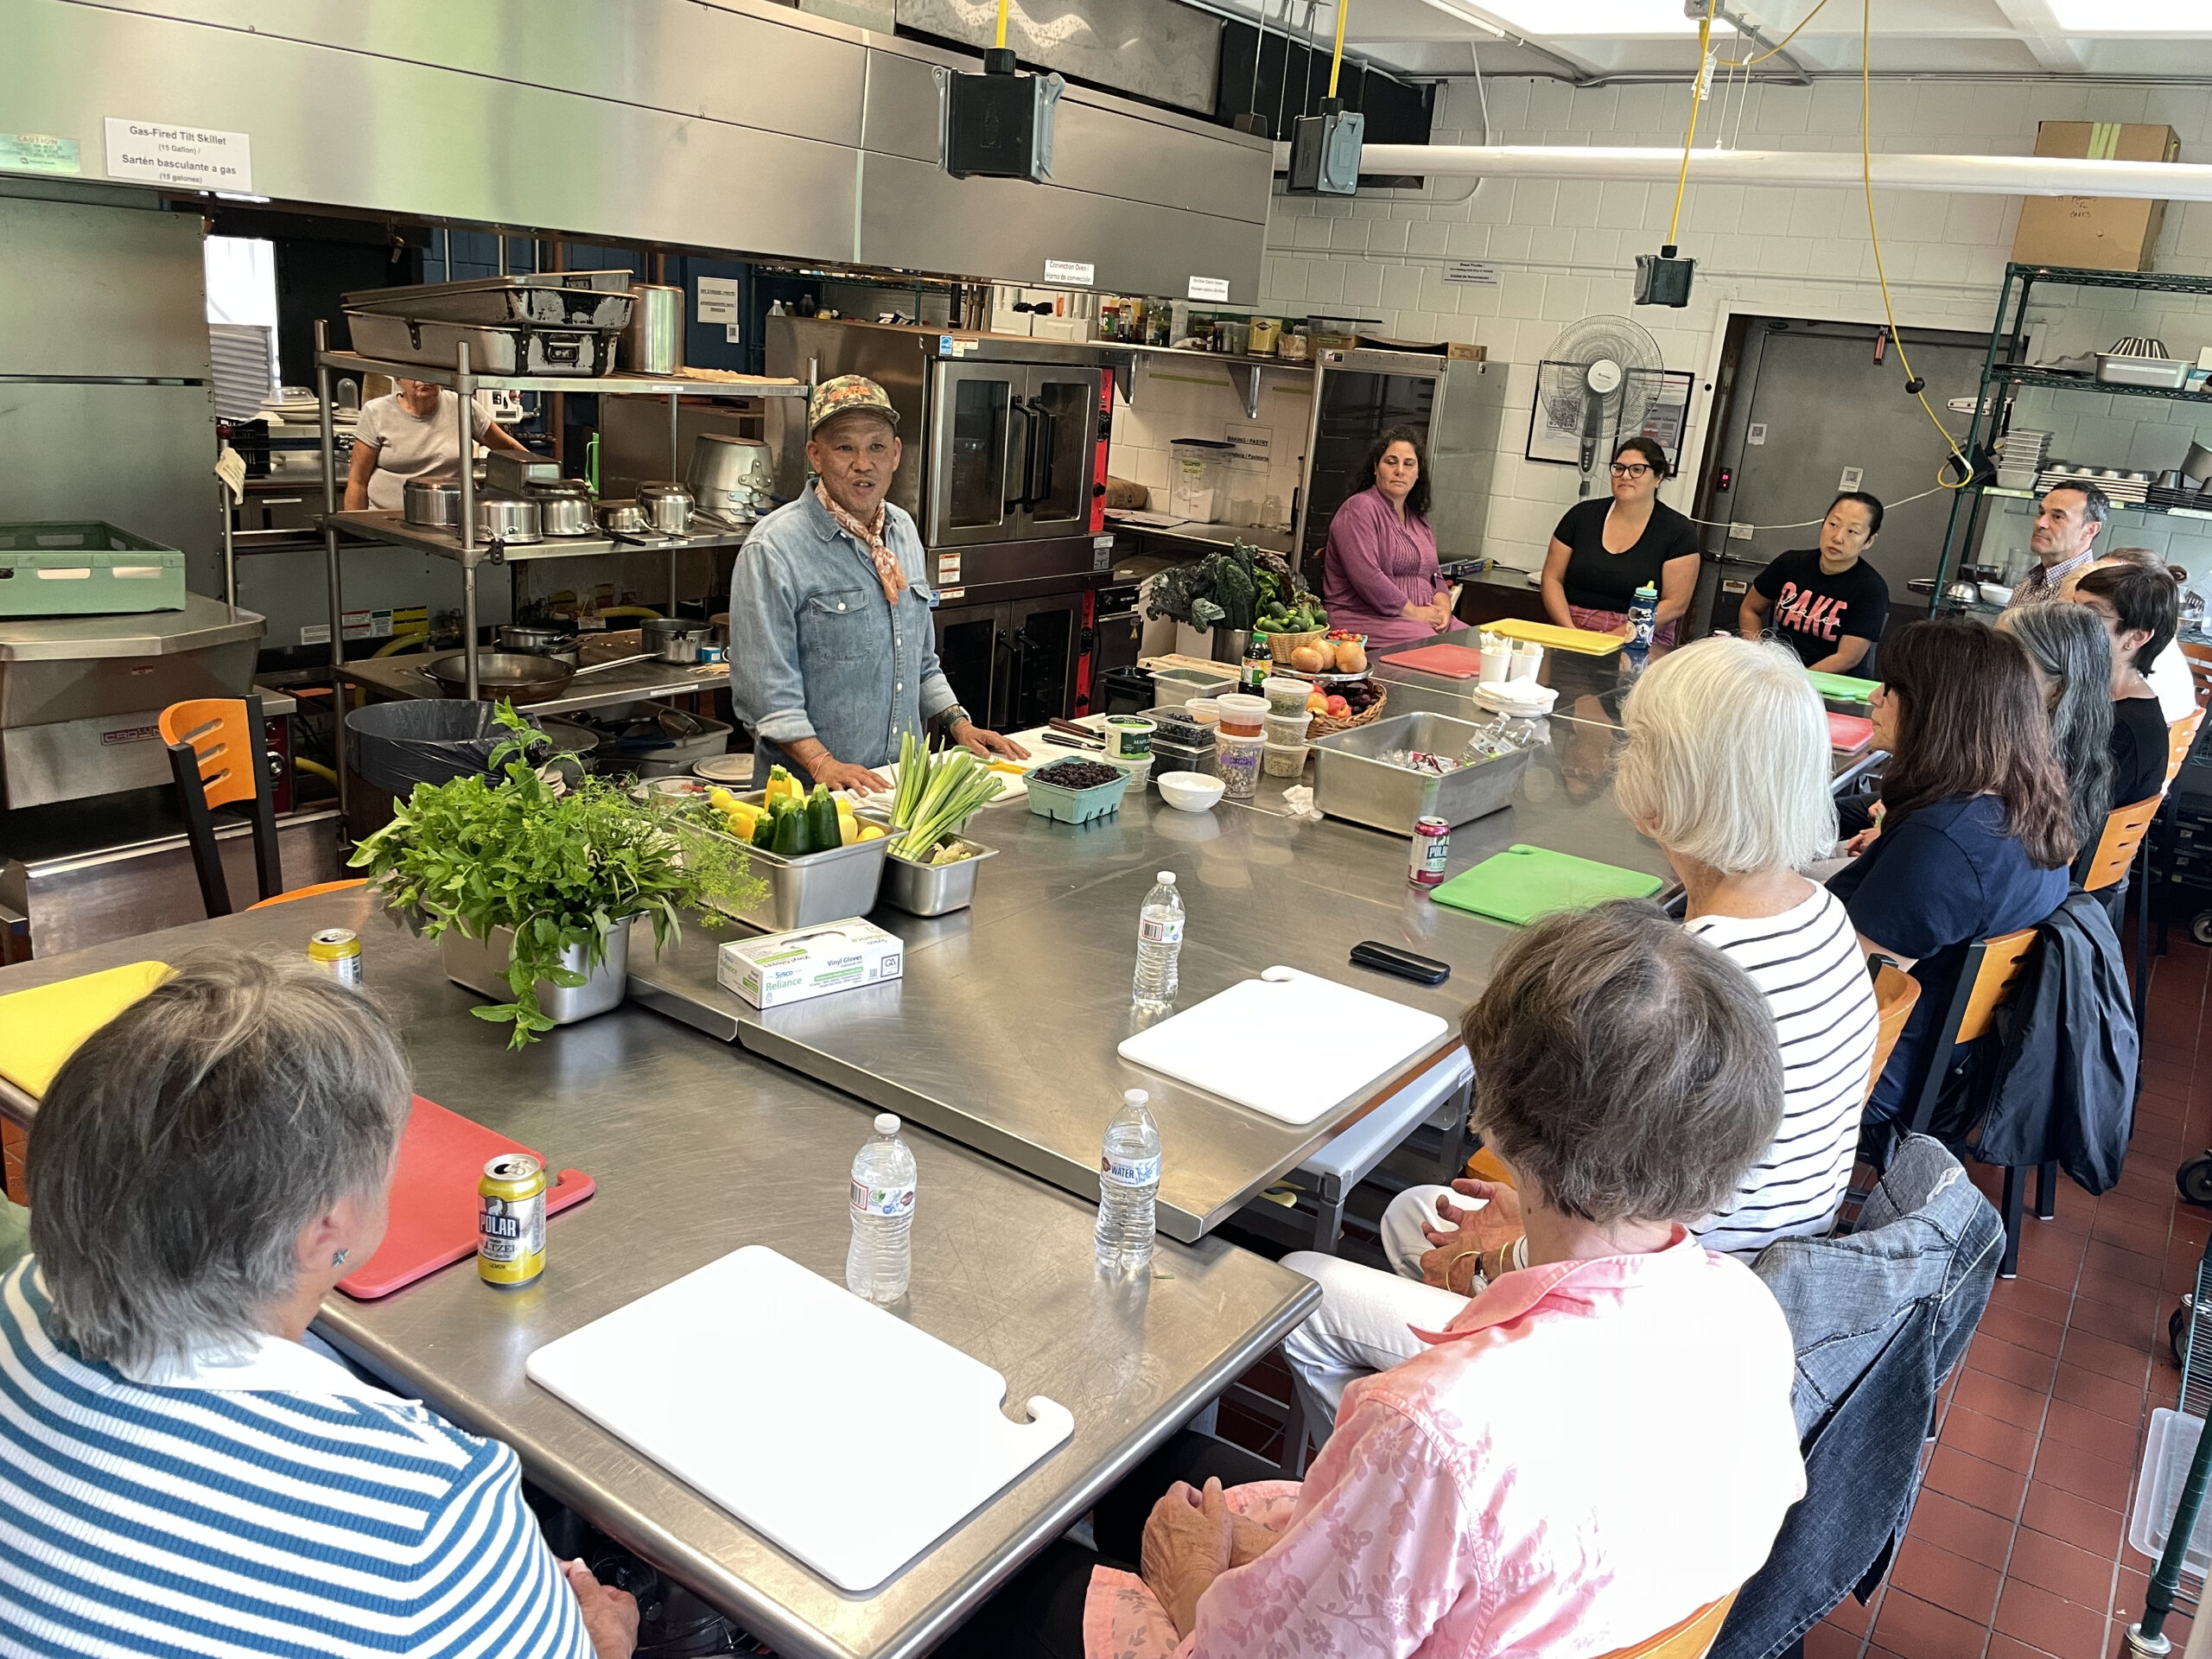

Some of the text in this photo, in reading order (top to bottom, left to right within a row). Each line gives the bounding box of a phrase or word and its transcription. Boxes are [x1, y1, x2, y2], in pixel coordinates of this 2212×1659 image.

[17, 136, 58, 145] CAUTION
[130, 125, 227, 146] Gas-Fired Tilt Skillet
[159, 144, 170, 152] (15
[171, 145, 197, 155] Gallon)
[122, 154, 155, 166] Sartén
[157, 158, 209, 172] basculante
[220, 166, 237, 175] gas
[159, 172, 203, 184] (15 galones)
[1049, 261, 1074, 270] Convection
[1429, 846, 1448, 858] POLA
[827, 958, 842, 967] Vinyl
[843, 955, 862, 963] Gloves
[775, 970, 793, 979] Sysco
[766, 978, 802, 992] Reliance
[1112, 1165, 1134, 1179] WATER
[480, 1213, 517, 1237] POLAR
[480, 1241, 518, 1253] LTZER
